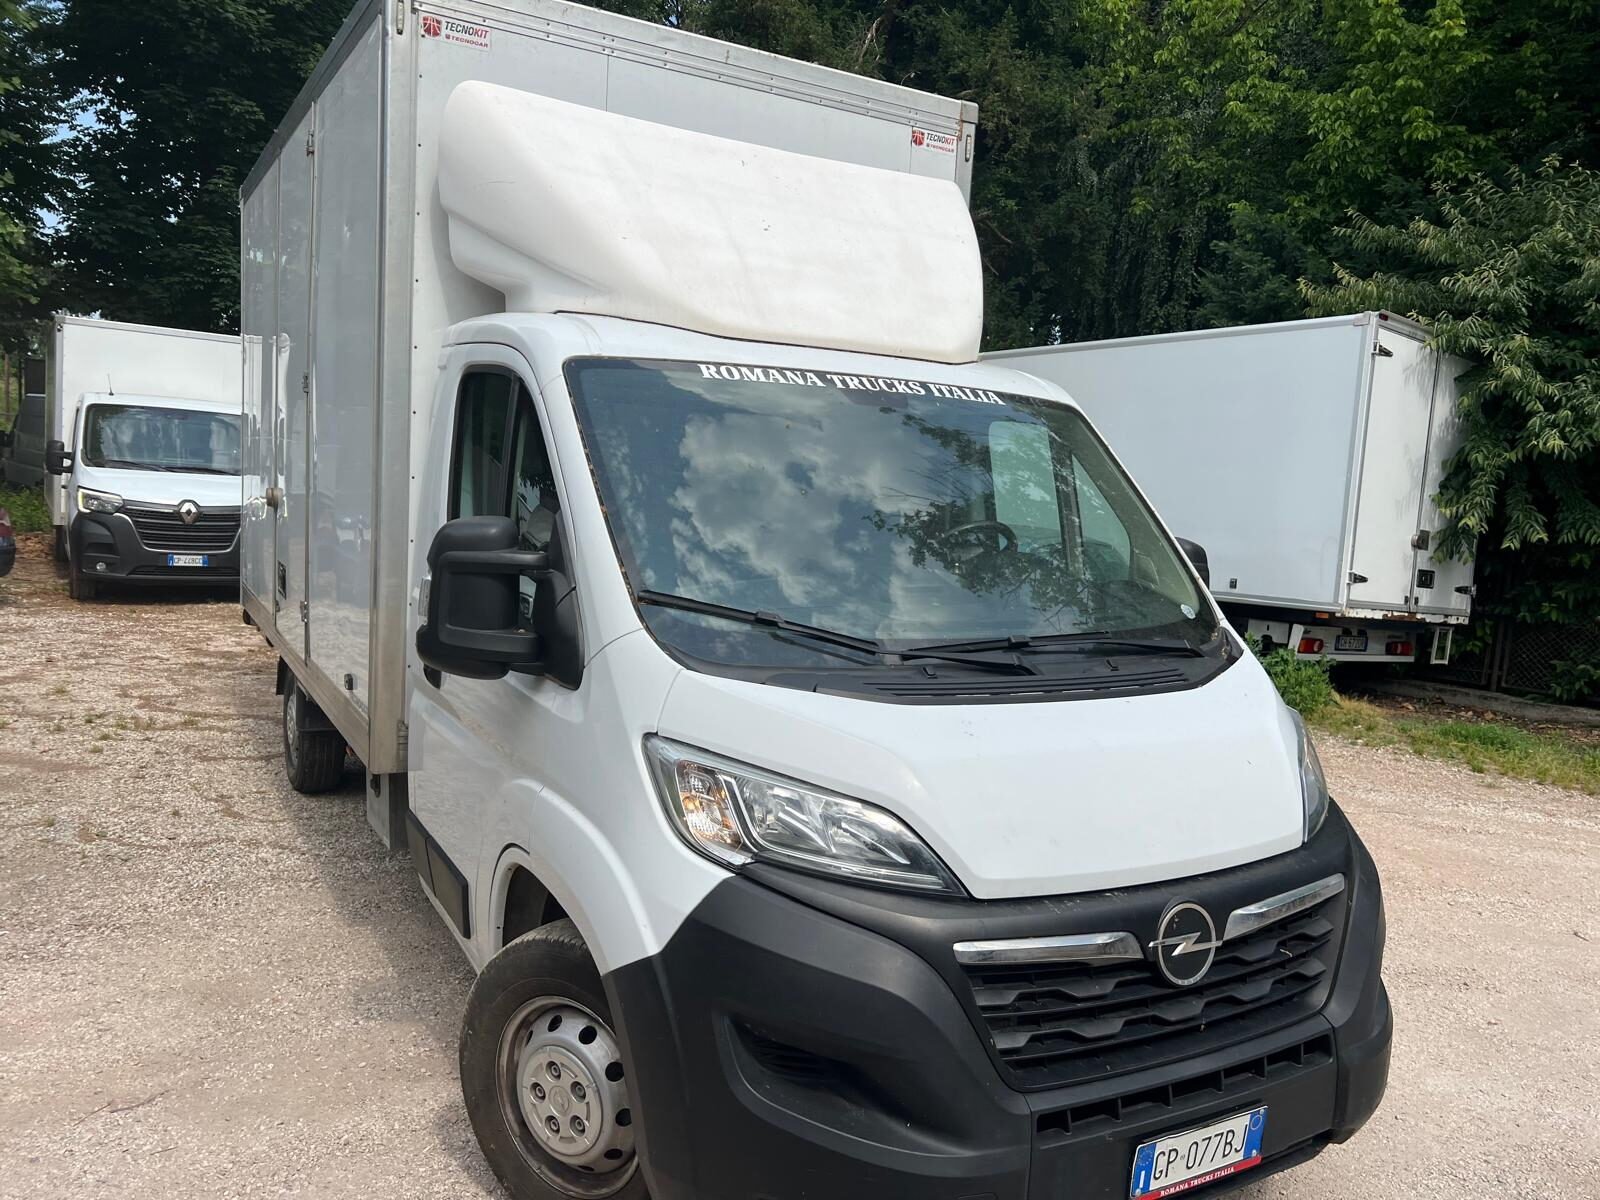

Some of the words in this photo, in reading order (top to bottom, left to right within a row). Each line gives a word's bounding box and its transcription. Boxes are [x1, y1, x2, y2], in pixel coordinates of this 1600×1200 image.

[445, 21, 489, 39] TECNOKIT
[451, 36, 489, 48] TECNOCAR
[927, 133, 955, 145] TECNOKIT
[697, 363, 826, 387] ROMANA
[826, 374, 926, 395] TRUCKS
[927, 383, 1006, 406] ITALIA
[1153, 1148, 1179, 1180] GP
[1185, 1124, 1248, 1169] 077BJ
[1160, 1183, 1189, 1197] ROMANA
[1190, 1175, 1214, 1187] TRUCKS
[1213, 1166, 1235, 1179] ITALIA
